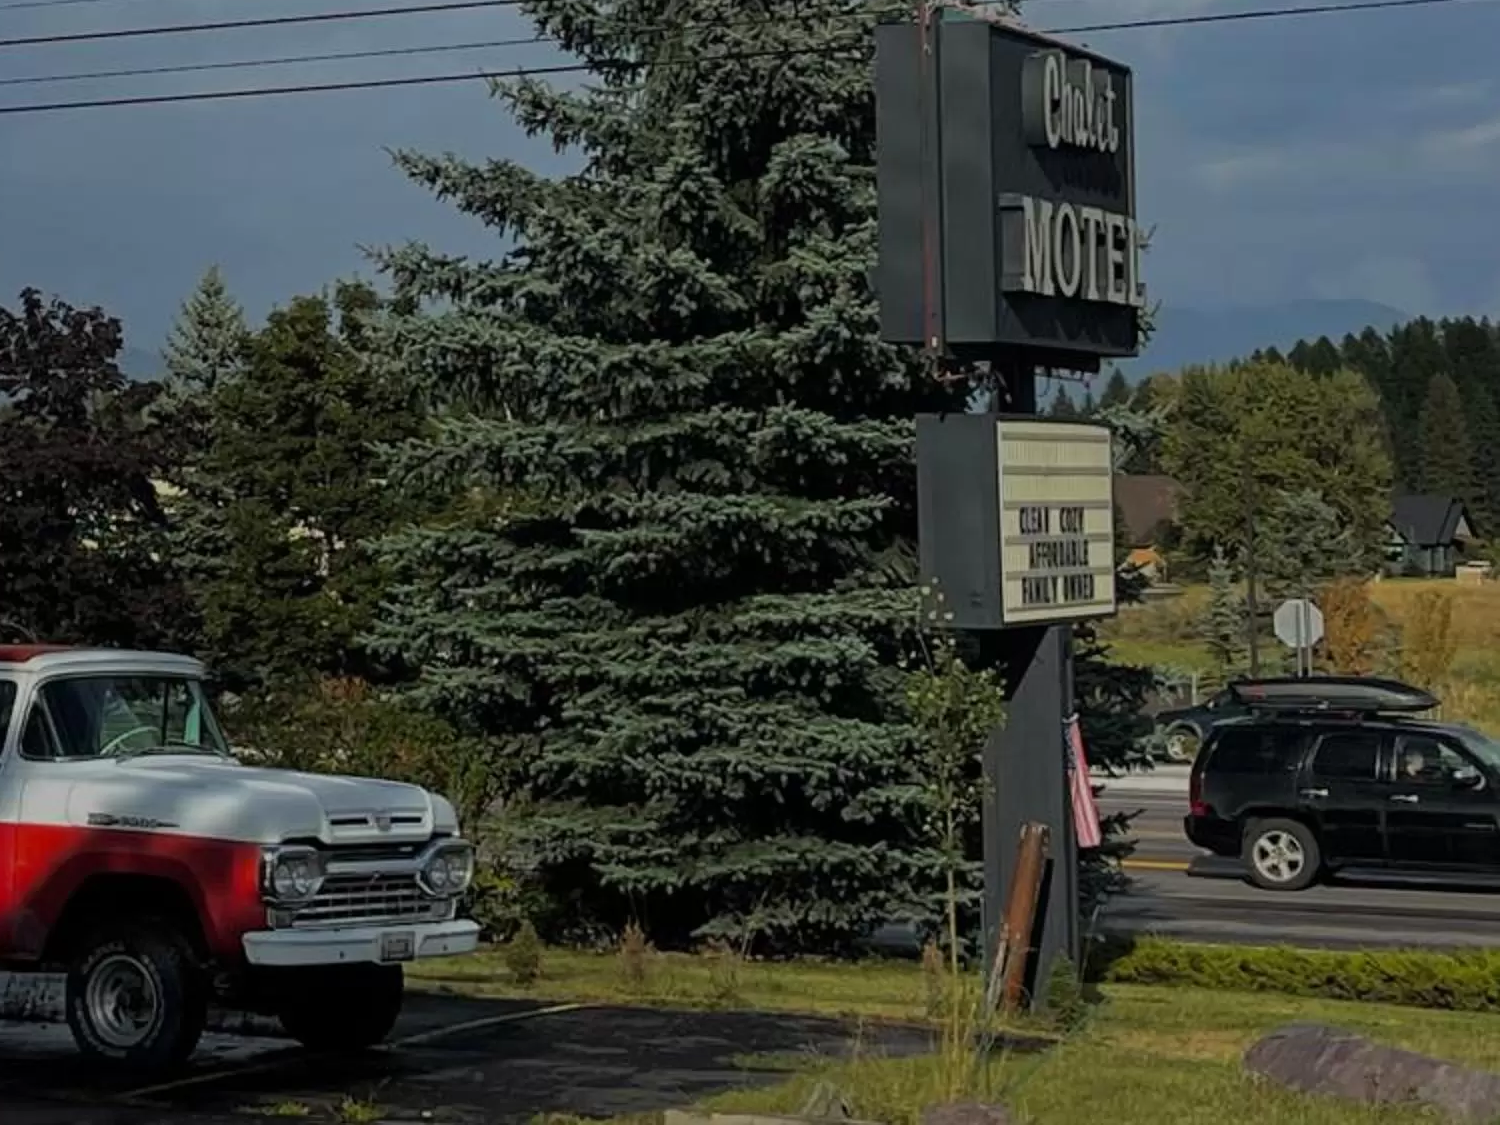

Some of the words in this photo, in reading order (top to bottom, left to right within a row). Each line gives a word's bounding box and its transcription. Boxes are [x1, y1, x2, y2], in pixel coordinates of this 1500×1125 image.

[1022, 195, 1146, 307] MOTEL
[1019, 506, 1049, 534] CLEAN
[1022, 575, 1058, 604] FAMILY
